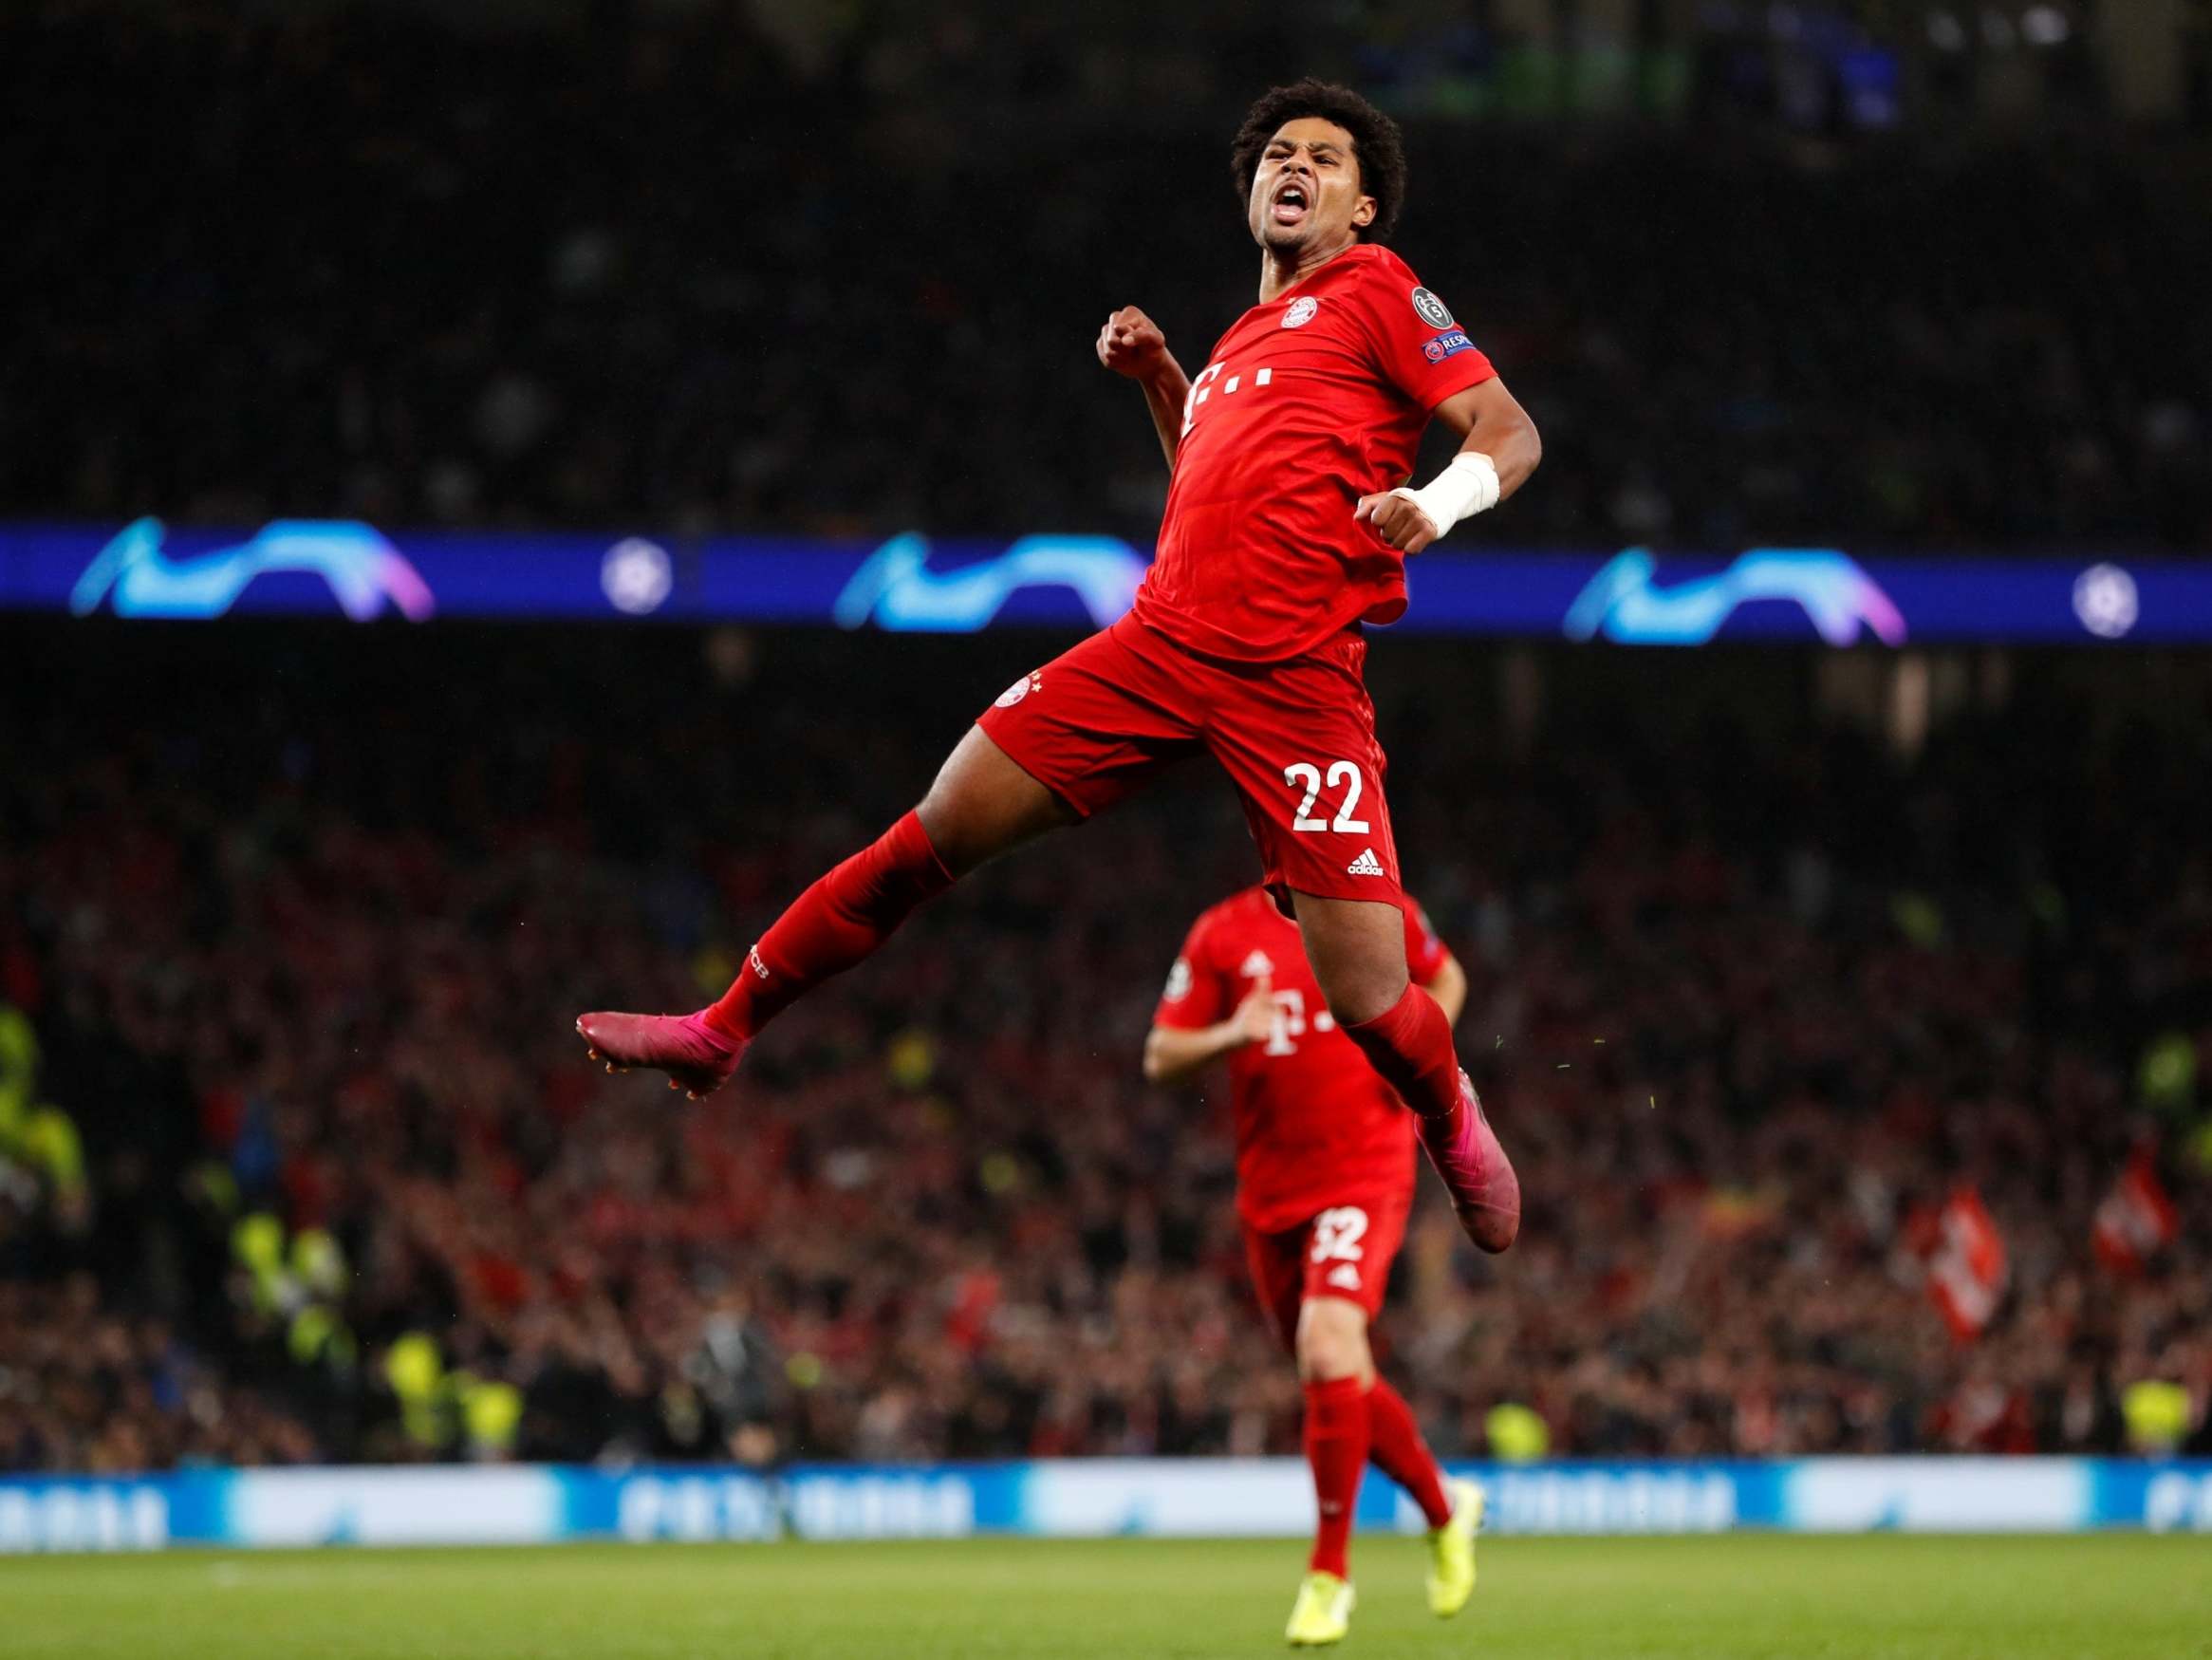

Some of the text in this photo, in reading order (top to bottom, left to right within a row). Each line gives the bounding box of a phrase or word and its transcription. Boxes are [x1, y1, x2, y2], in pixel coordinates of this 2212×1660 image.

[1431, 306, 1442, 318] 5
[1442, 334, 1473, 350] RESP
[1284, 760, 1369, 834] 22
[1348, 865, 1384, 876] adidas
